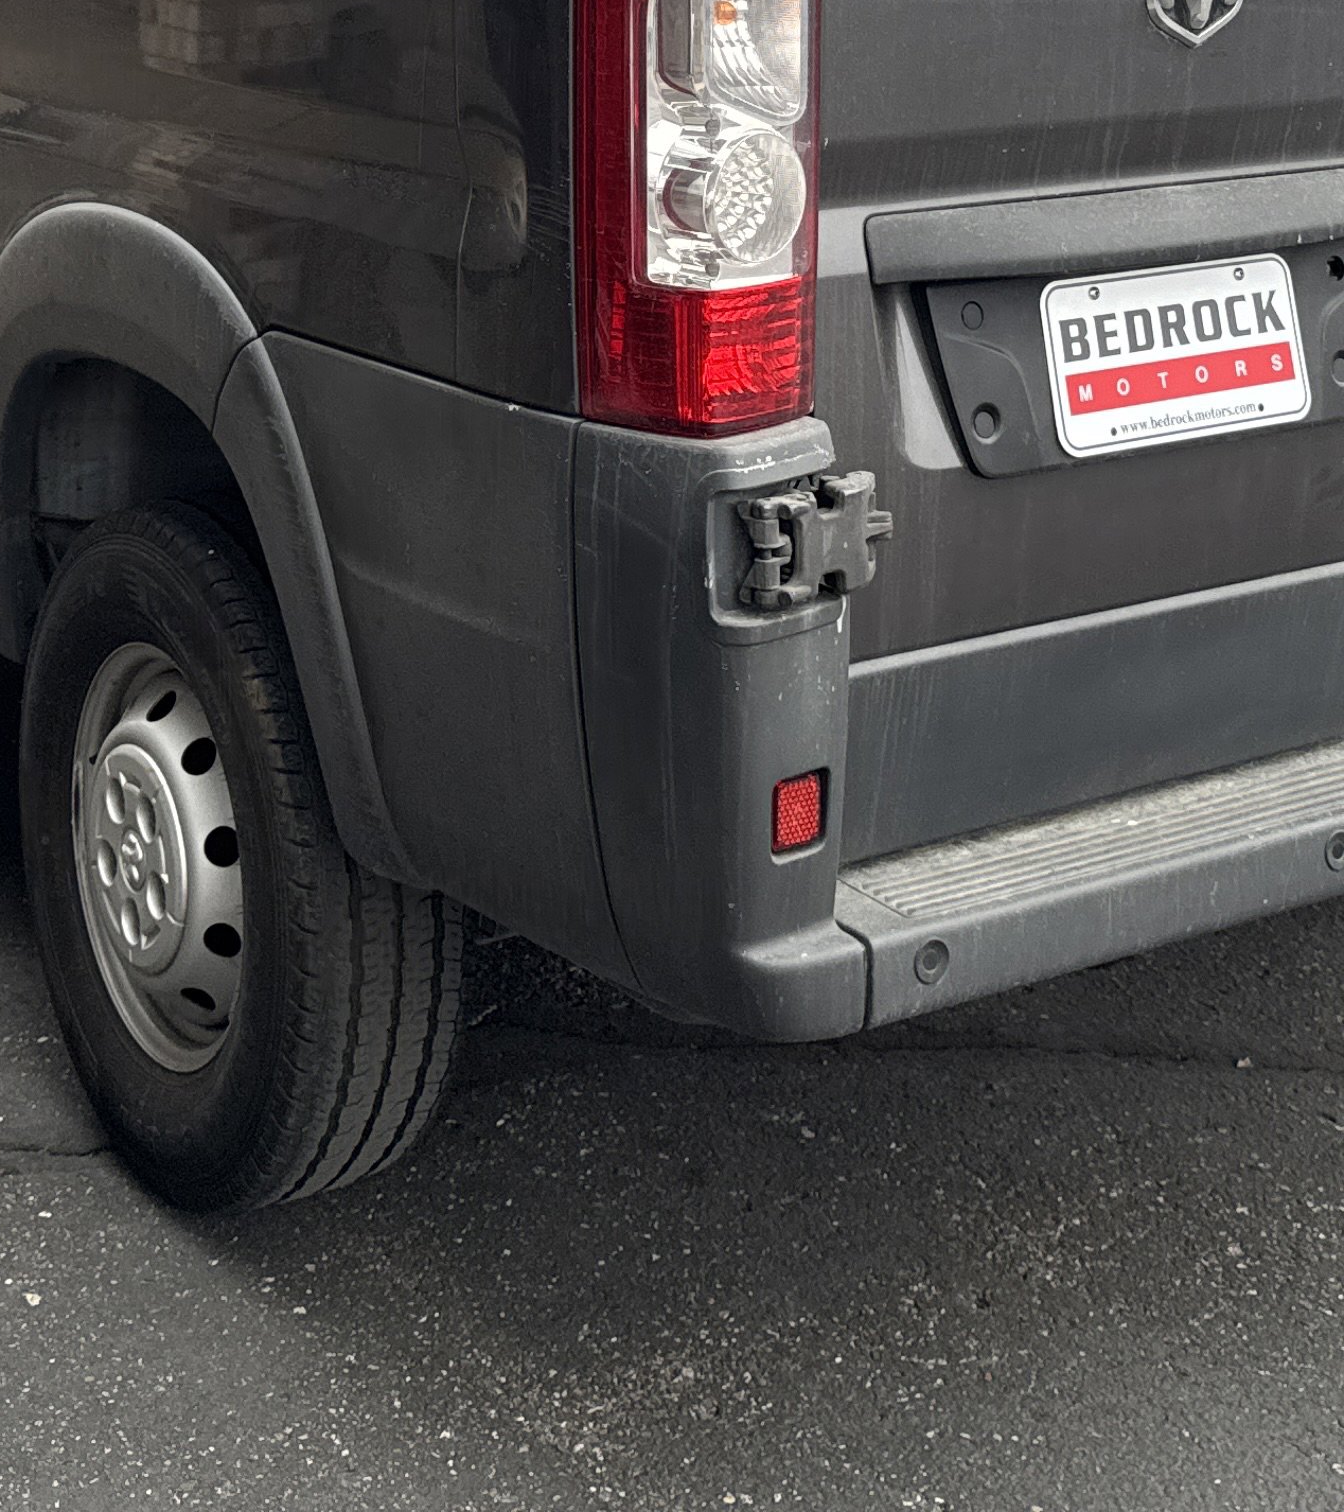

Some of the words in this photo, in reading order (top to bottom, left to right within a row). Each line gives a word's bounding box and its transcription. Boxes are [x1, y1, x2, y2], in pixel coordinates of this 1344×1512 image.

[1058, 289, 1286, 363] BEDROCK
[1078, 353, 1284, 403] MOTORS
[1120, 402, 1257, 435] www.bedrockmotors.com
